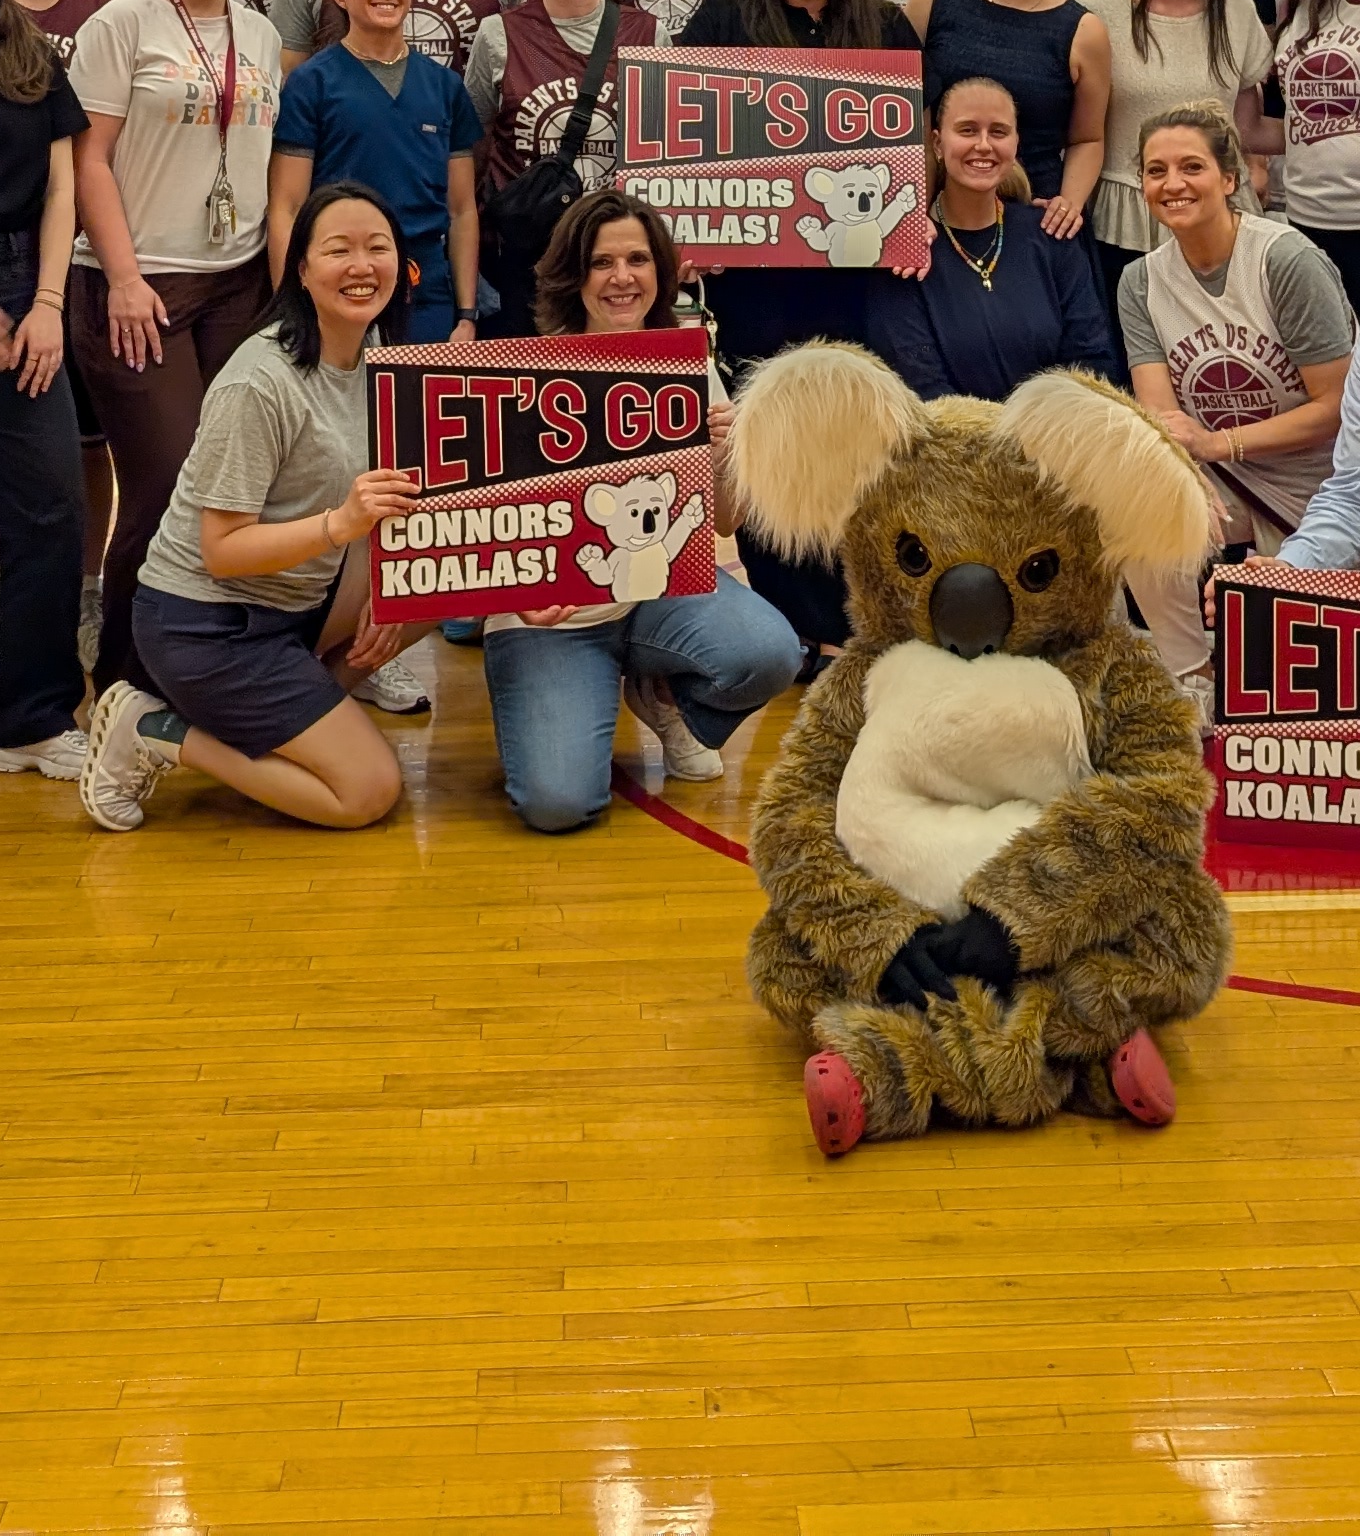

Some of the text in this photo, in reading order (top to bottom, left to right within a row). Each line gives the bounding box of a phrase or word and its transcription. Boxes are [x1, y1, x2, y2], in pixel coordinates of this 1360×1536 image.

[238, 52, 256, 67] A
[234, 83, 274, 105] FR
[1289, 82, 1360, 97] BASKETBALL
[514, 77, 615, 152] PARENTS S
[625, 65, 915, 164] LET'S GO
[539, 139, 618, 157] BATBALL
[625, 177, 795, 209] CONNORS
[660, 214, 780, 245] ALAS!
[1224, 322, 1248, 351] VS
[1191, 391, 1277, 410] BASKETBALL
[375, 372, 702, 491] LET'S GO
[379, 500, 574, 552] CONNORS
[380, 545, 558, 598] KOALAS!
